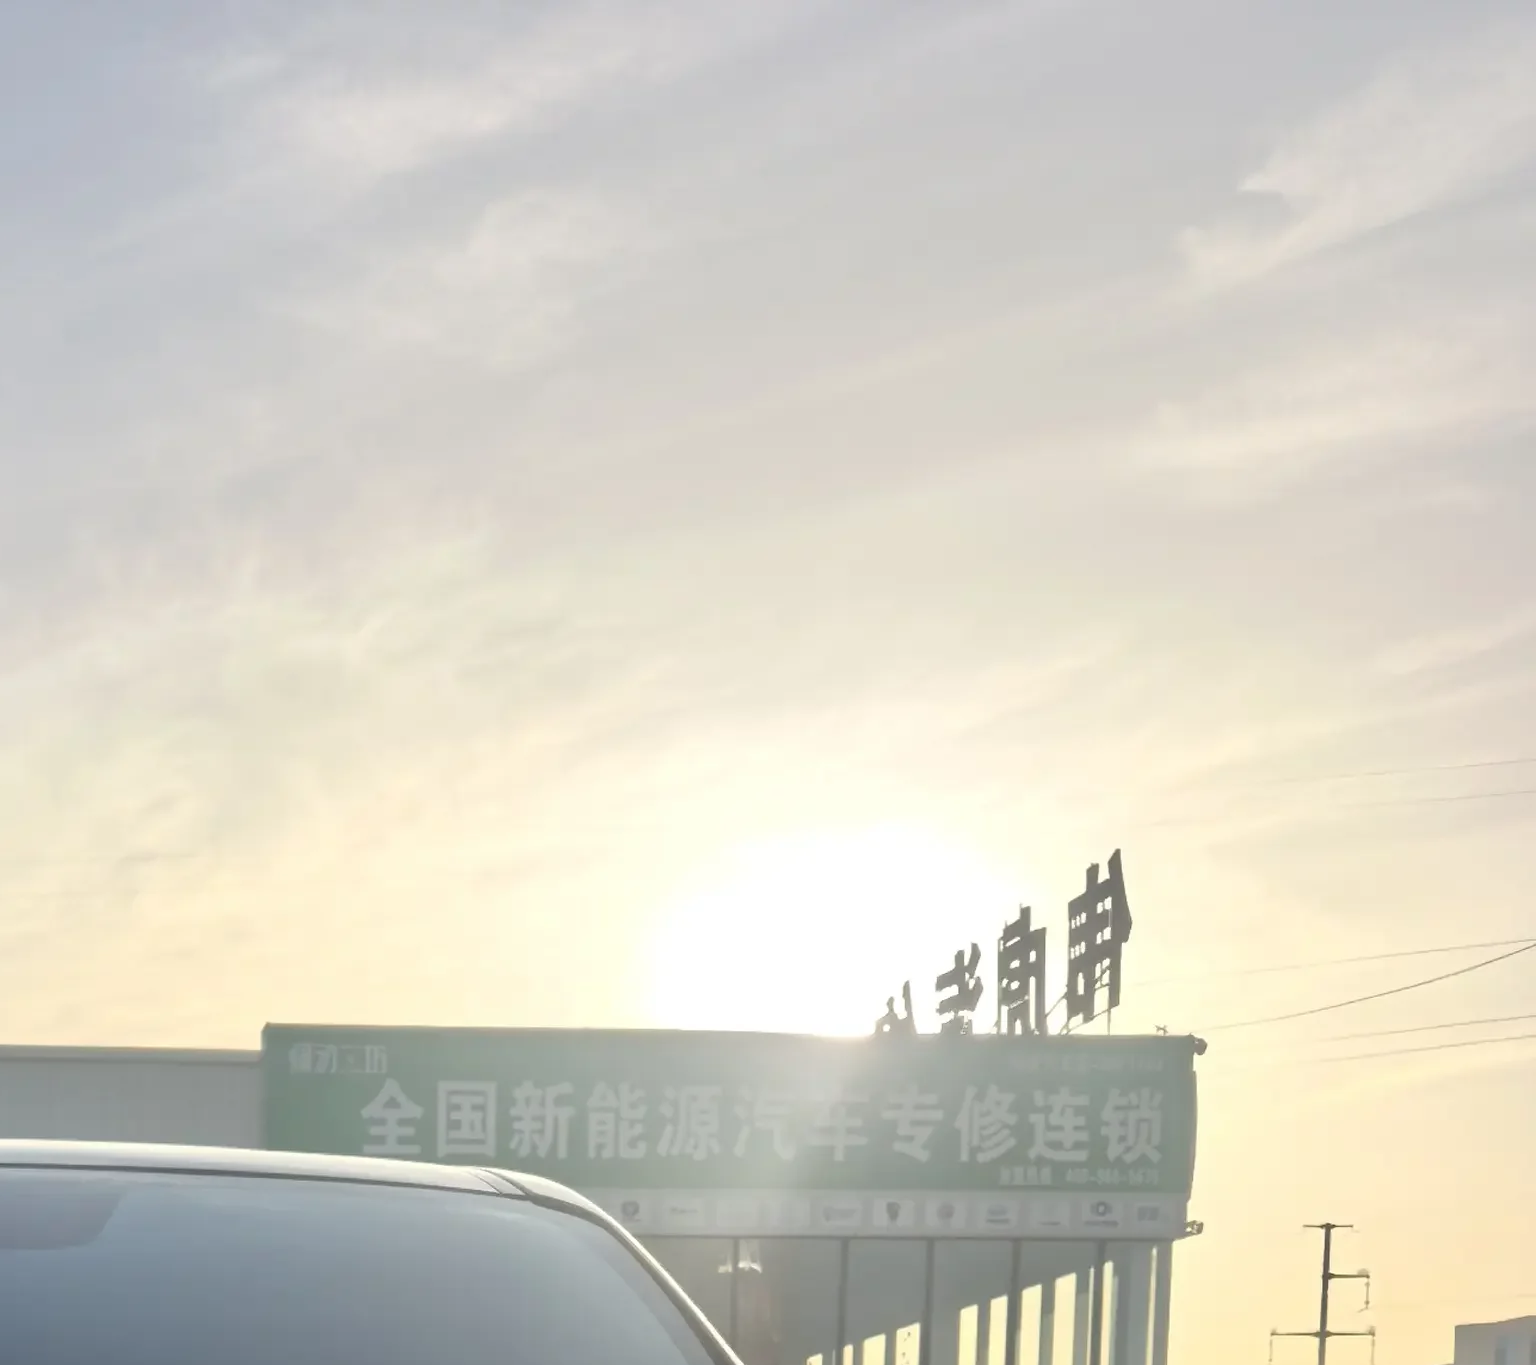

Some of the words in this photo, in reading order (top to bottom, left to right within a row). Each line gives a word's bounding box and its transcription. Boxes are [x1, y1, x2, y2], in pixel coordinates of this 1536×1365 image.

[360, 1078, 1164, 1164] 全国新能源汽车专修连锁
